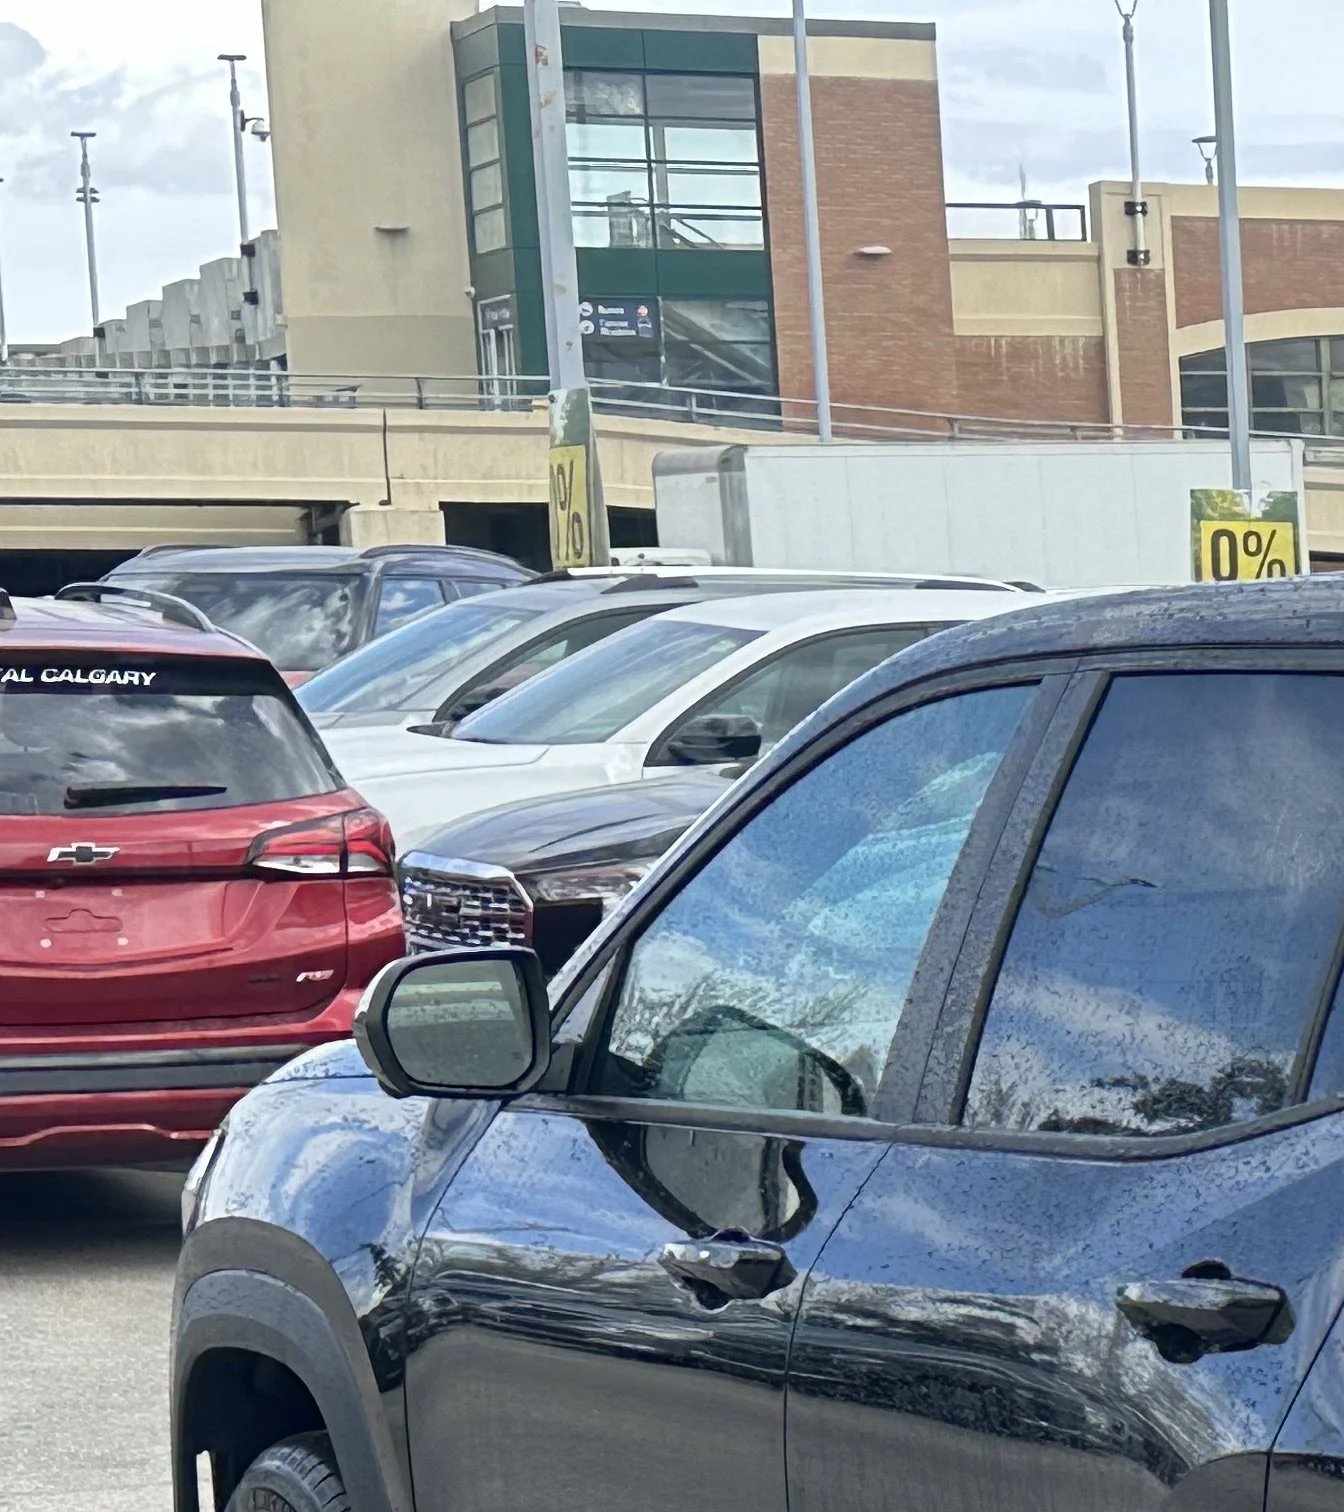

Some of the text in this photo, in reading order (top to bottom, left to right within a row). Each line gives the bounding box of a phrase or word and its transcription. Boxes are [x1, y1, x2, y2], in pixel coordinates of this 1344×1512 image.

[1211, 528, 1287, 581] 0%
[0, 668, 157, 686] AL CALGARY
